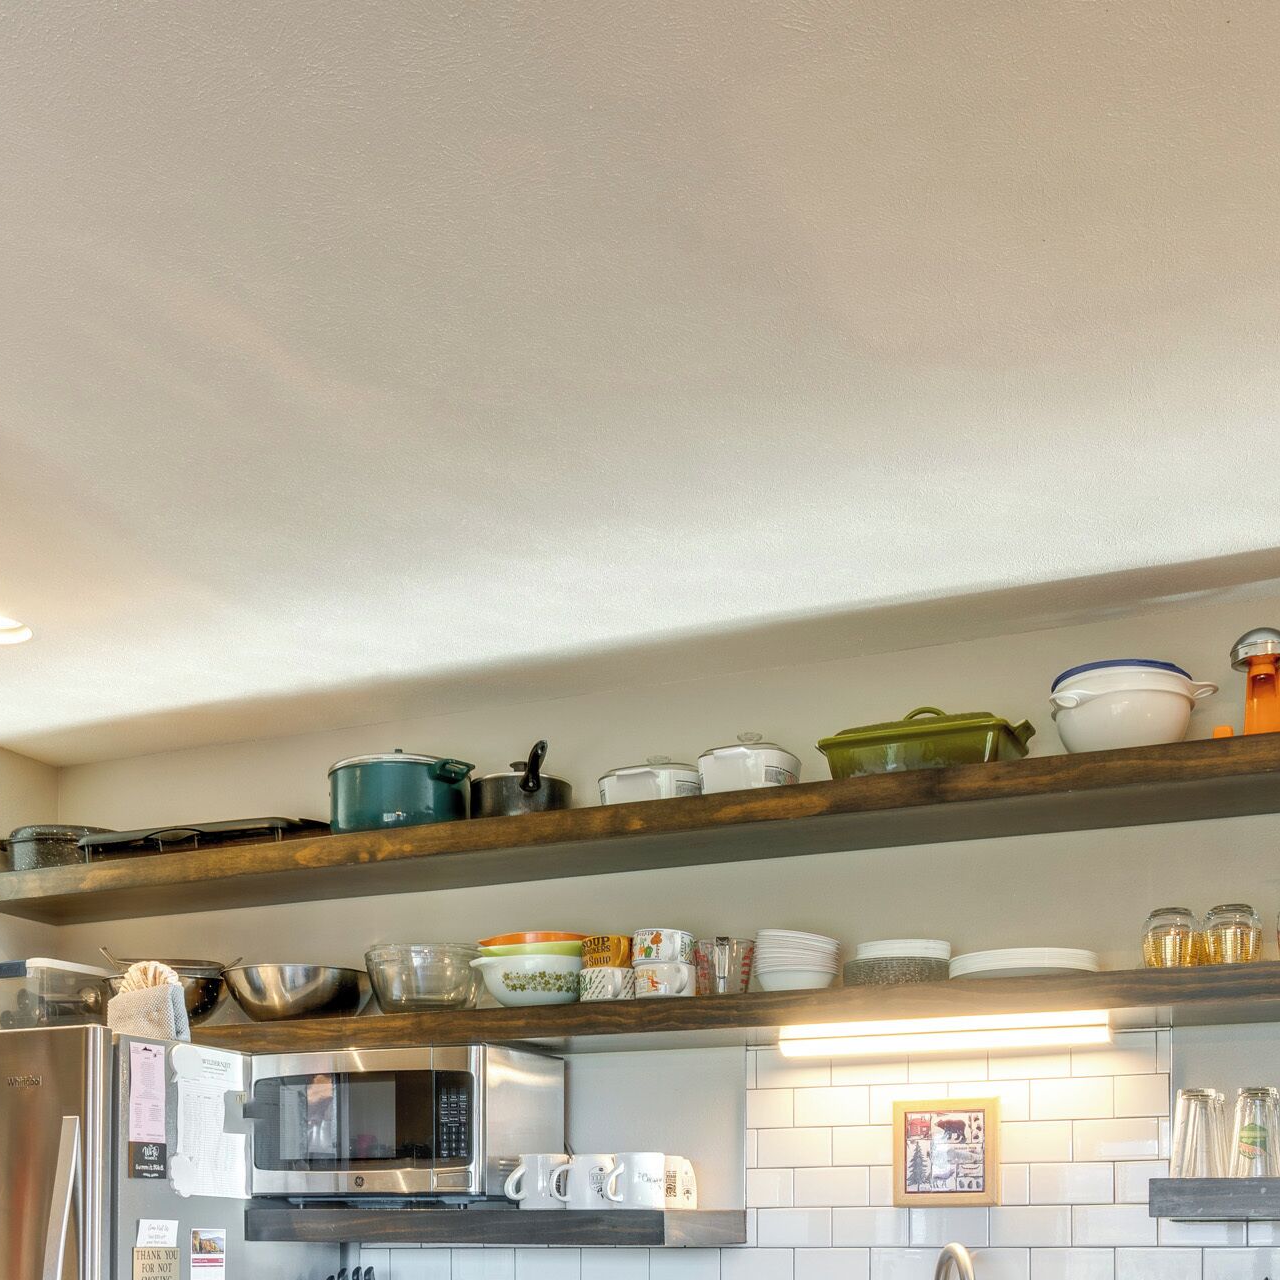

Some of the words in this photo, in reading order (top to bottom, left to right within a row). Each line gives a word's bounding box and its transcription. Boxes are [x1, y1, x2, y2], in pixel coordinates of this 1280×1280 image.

[135, 1250, 162, 1261] THANK
[164, 1250, 179, 1260] YOU
[141, 1263, 155, 1273] FOR
[157, 1263, 173, 1273] NOT
